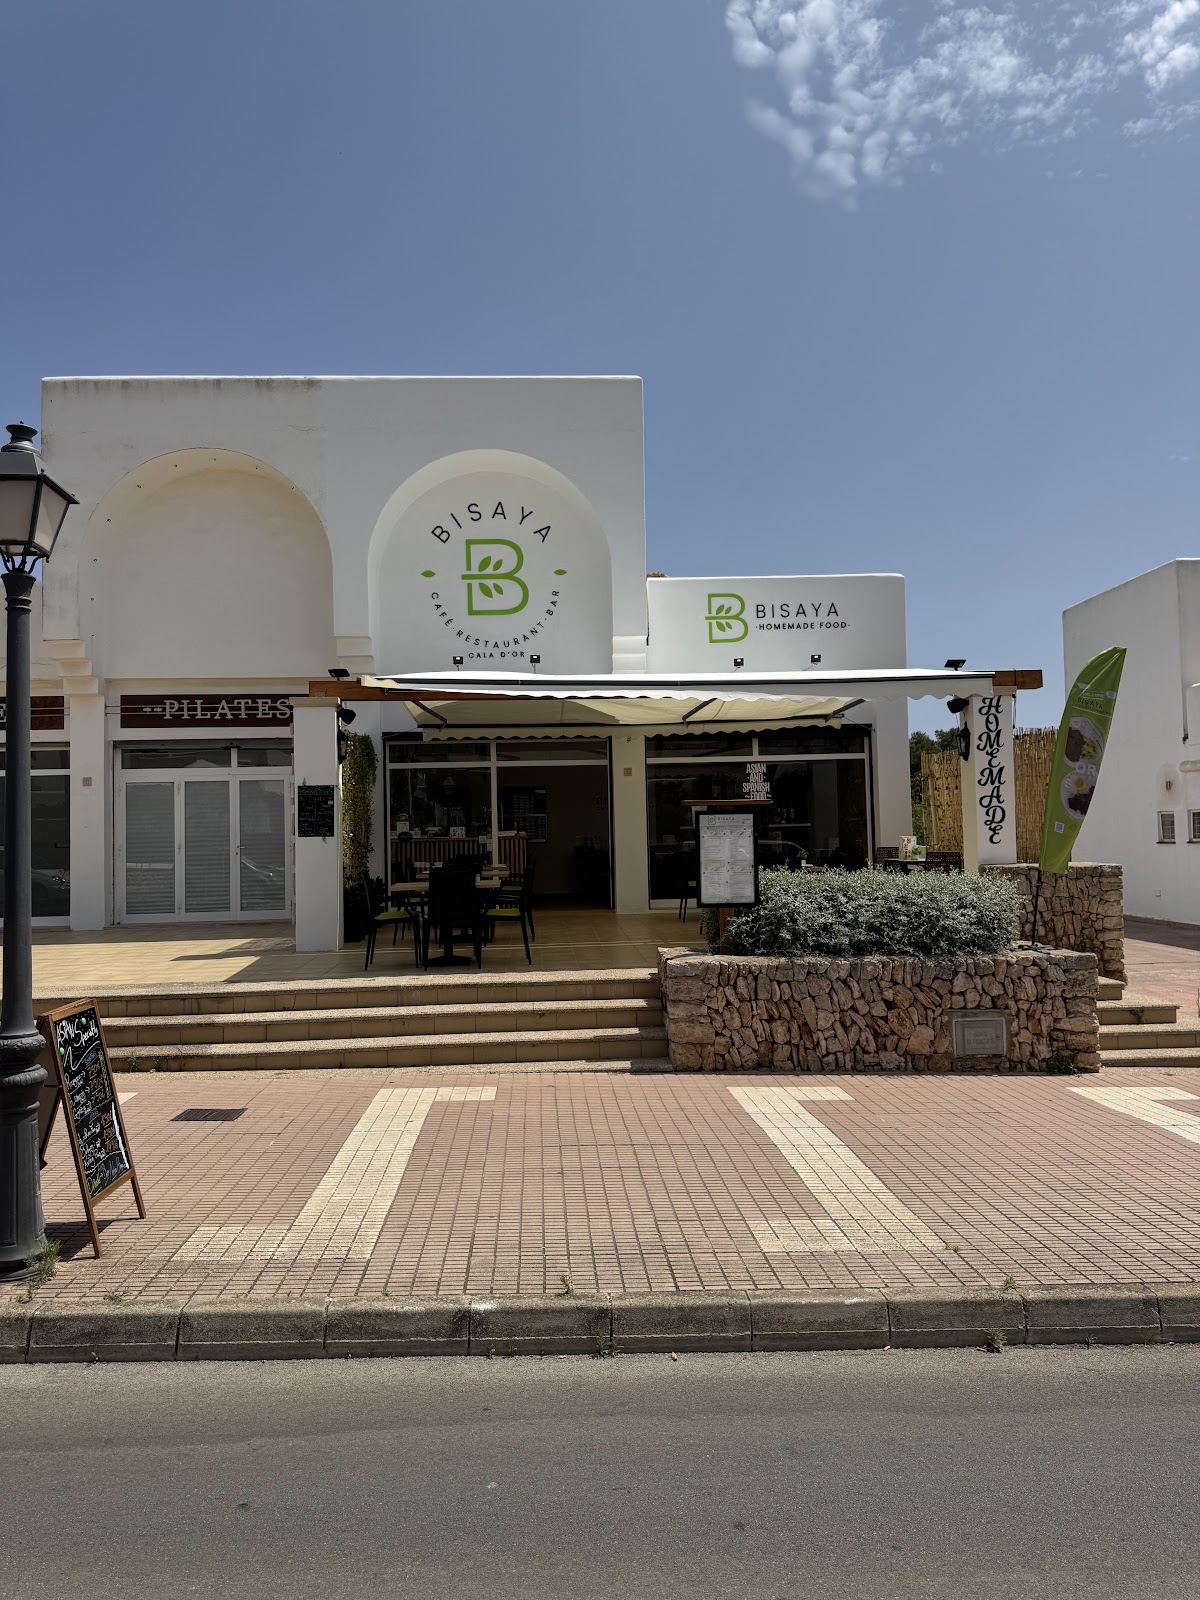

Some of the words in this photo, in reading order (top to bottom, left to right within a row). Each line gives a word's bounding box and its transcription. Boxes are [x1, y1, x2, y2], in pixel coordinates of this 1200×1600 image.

[431, 501, 551, 544] BISAYA
[756, 603, 839, 618] BISAYA
[431, 592, 454, 626] CAFÉ
[456, 621, 544, 649] RESTAURANT
[545, 590, 560, 616] BAR
[163, 699, 291, 719] PILATES
[1077, 697, 1103, 709] BISAYA
[746, 763, 766, 773] ASIAN
[976, 695, 1006, 844] HOMEMADE
[1075, 762, 1097, 777] OR
[750, 773, 763, 783] AND
[742, 782, 770, 792] SPANISH
